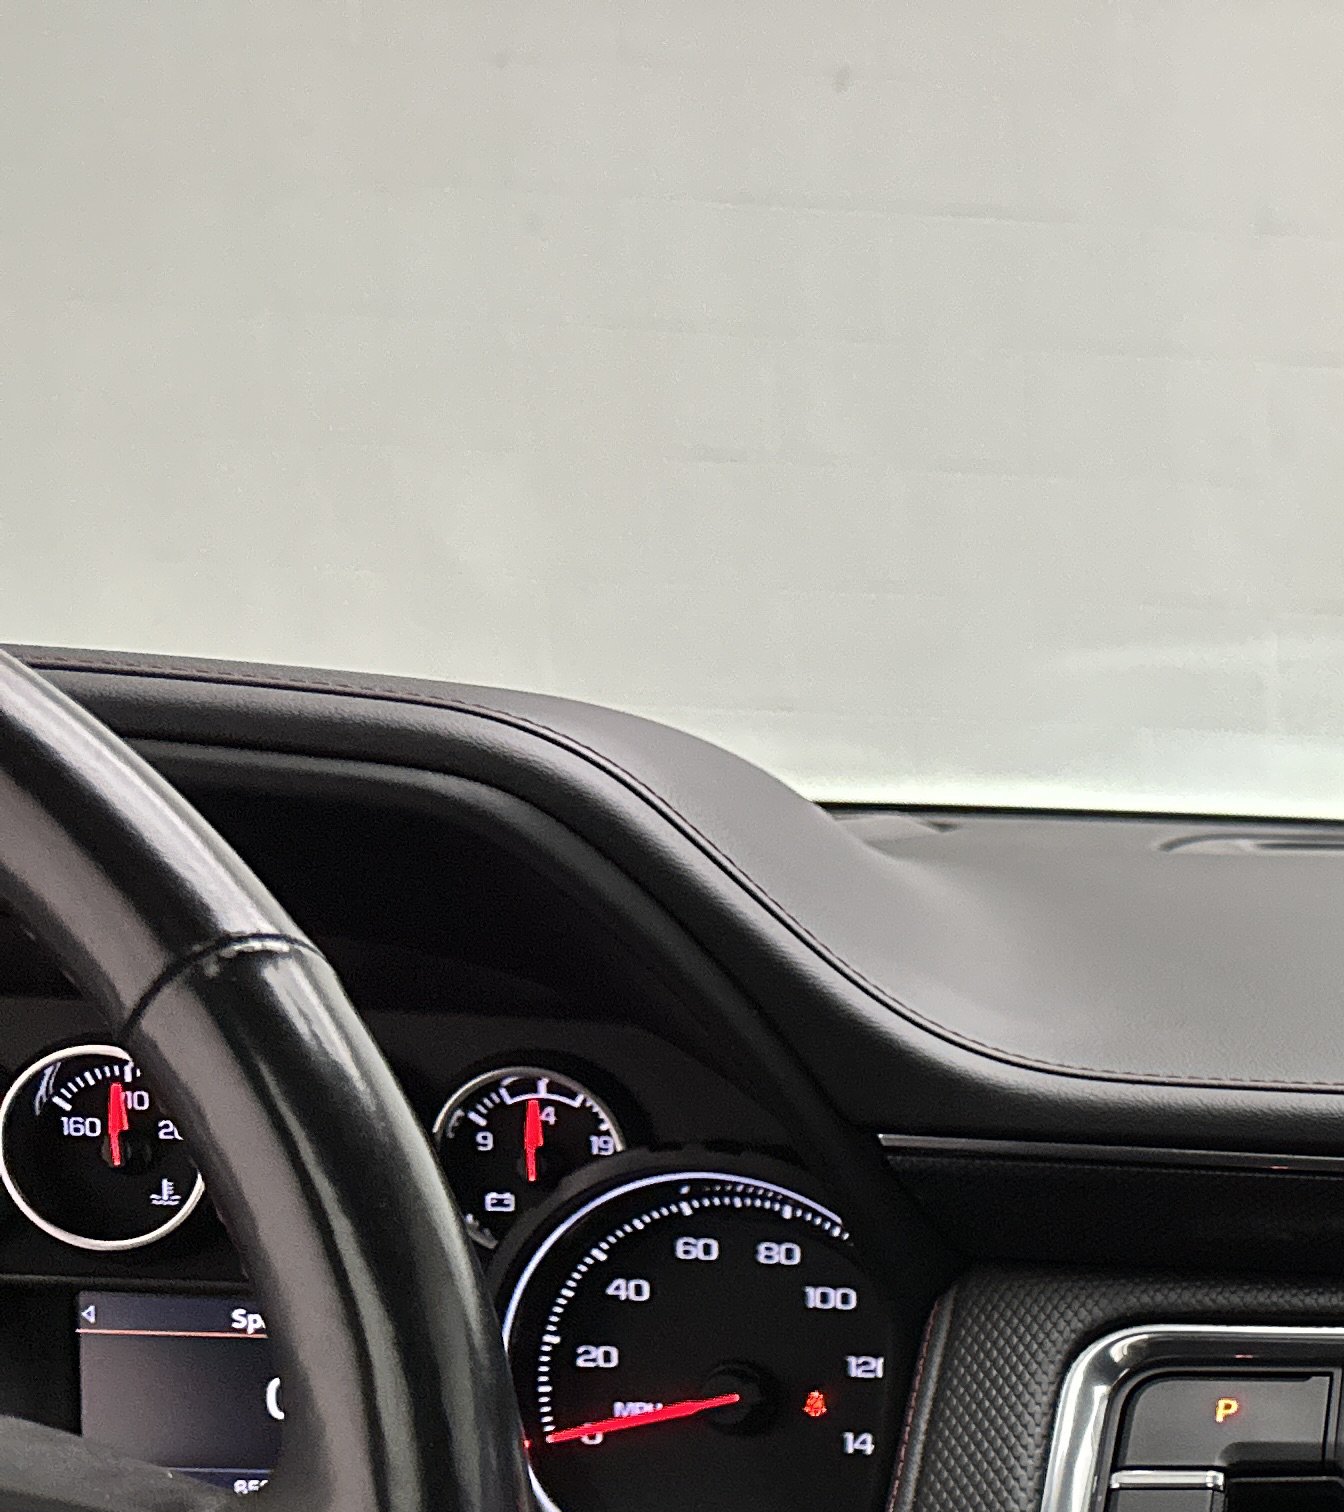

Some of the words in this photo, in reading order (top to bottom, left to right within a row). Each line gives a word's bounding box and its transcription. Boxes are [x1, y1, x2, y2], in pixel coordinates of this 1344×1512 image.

[60, 1116, 101, 1136] 160
[476, 1132, 493, 1151] 9
[589, 1134, 614, 1155] 19
[676, 1237, 719, 1260] 60
[757, 1242, 801, 1265] 80
[606, 1279, 650, 1301] 40
[805, 1287, 857, 1310] 100
[576, 1345, 618, 1367] 20
[1216, 1398, 1239, 1422] P
